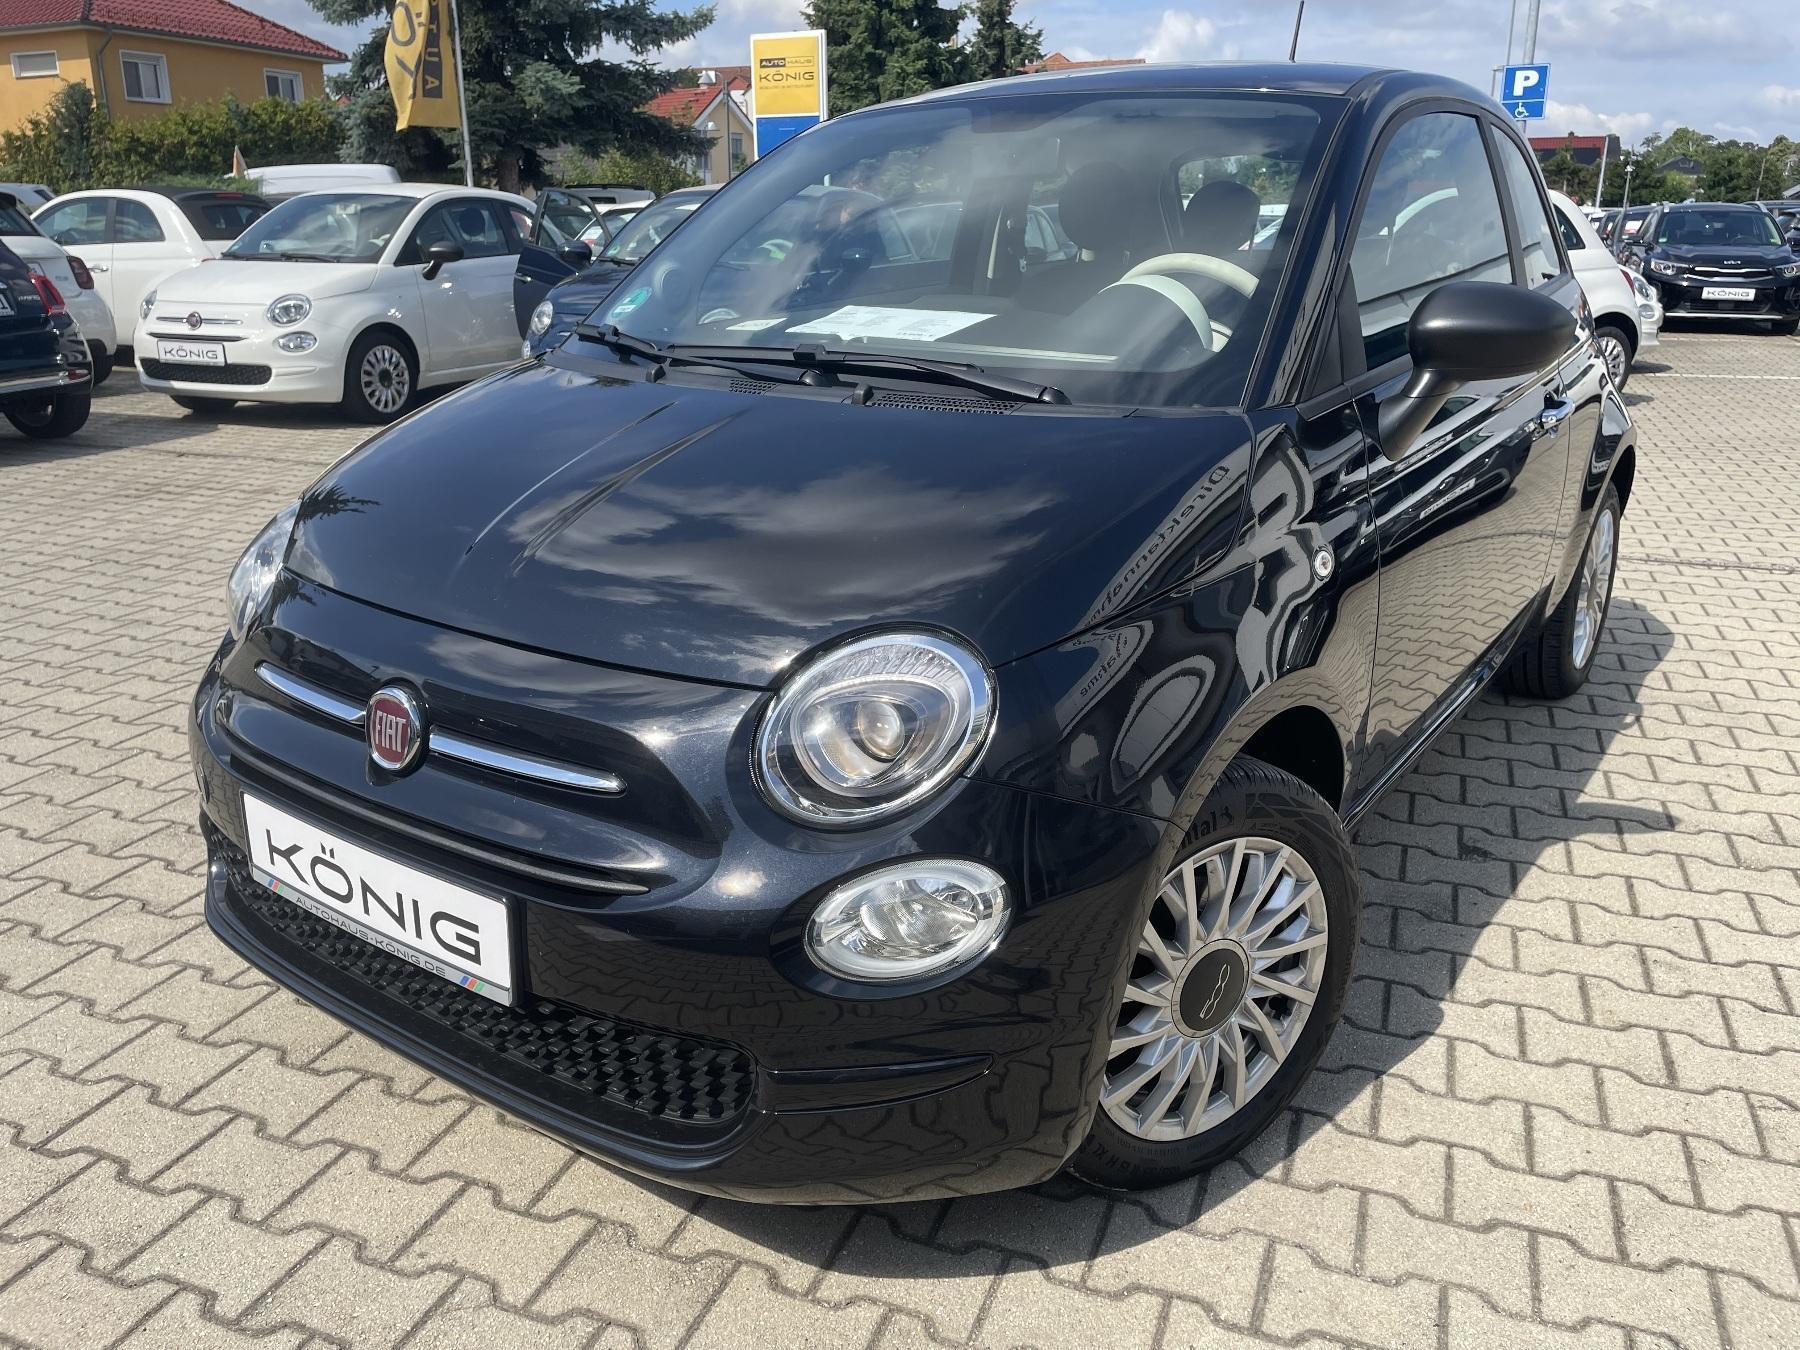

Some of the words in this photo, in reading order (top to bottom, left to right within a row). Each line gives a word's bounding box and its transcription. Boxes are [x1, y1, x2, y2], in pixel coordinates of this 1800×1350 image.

[759, 70, 815, 82] KÖNIG
[1513, 70, 1539, 96] P
[163, 345, 218, 360] KÖNIG
[375, 709, 407, 753] FIAT
[265, 828, 482, 966] KÖNIG
